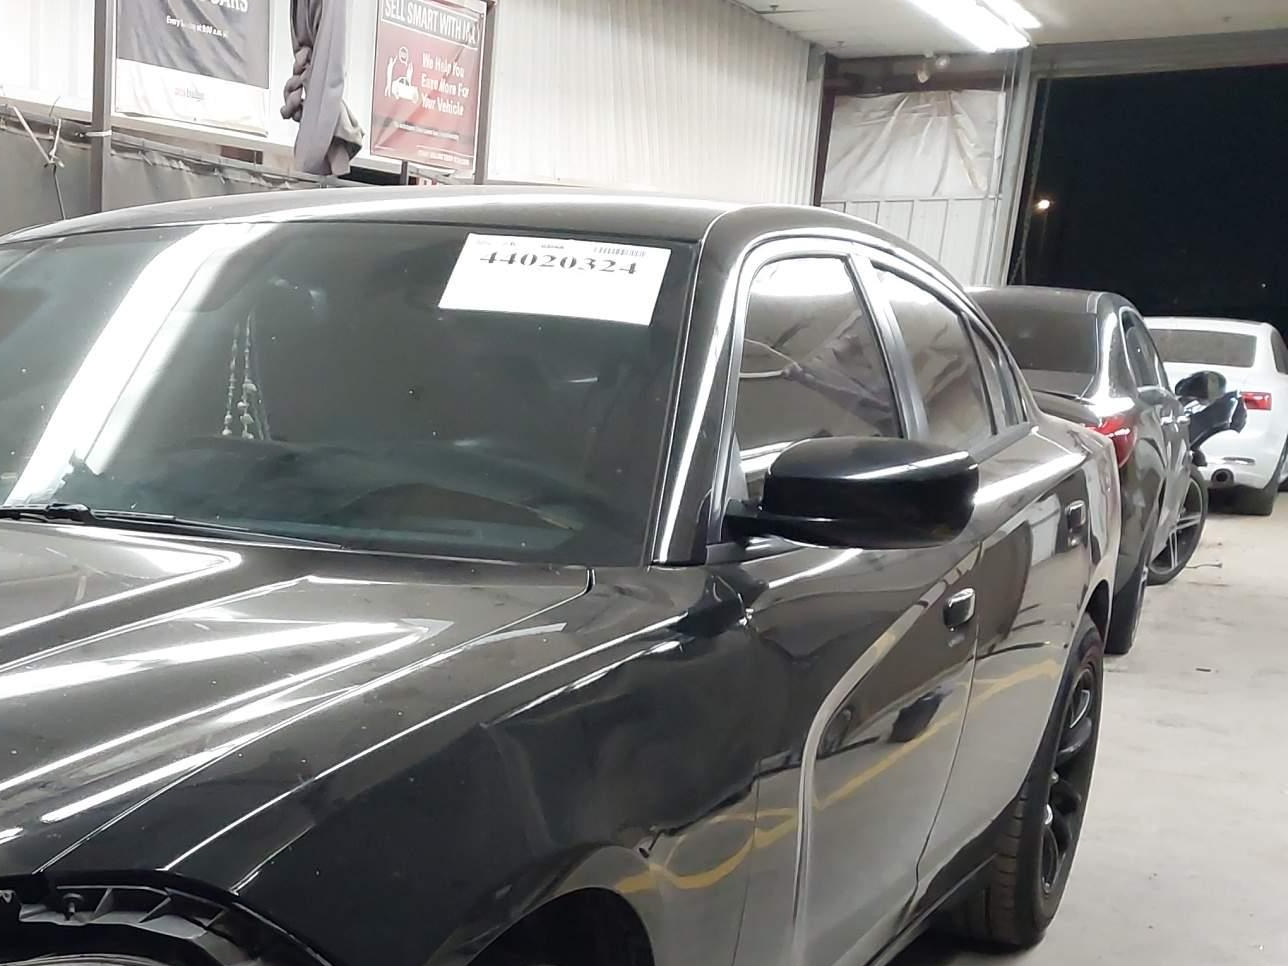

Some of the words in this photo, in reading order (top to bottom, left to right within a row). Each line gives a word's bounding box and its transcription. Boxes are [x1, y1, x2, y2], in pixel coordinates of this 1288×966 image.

[384, 0, 406, 22] SELL
[407, 2, 439, 33] SMART
[440, 12, 462, 42] WITH
[422, 52, 434, 70] We
[435, 56, 452, 77] Help
[452, 61, 465, 78] You
[439, 78, 457, 95] More
[458, 83, 470, 99] For
[421, 93, 436, 110] Your
[437, 97, 465, 116] Vehicle
[479, 251, 637, 275] 44020324
